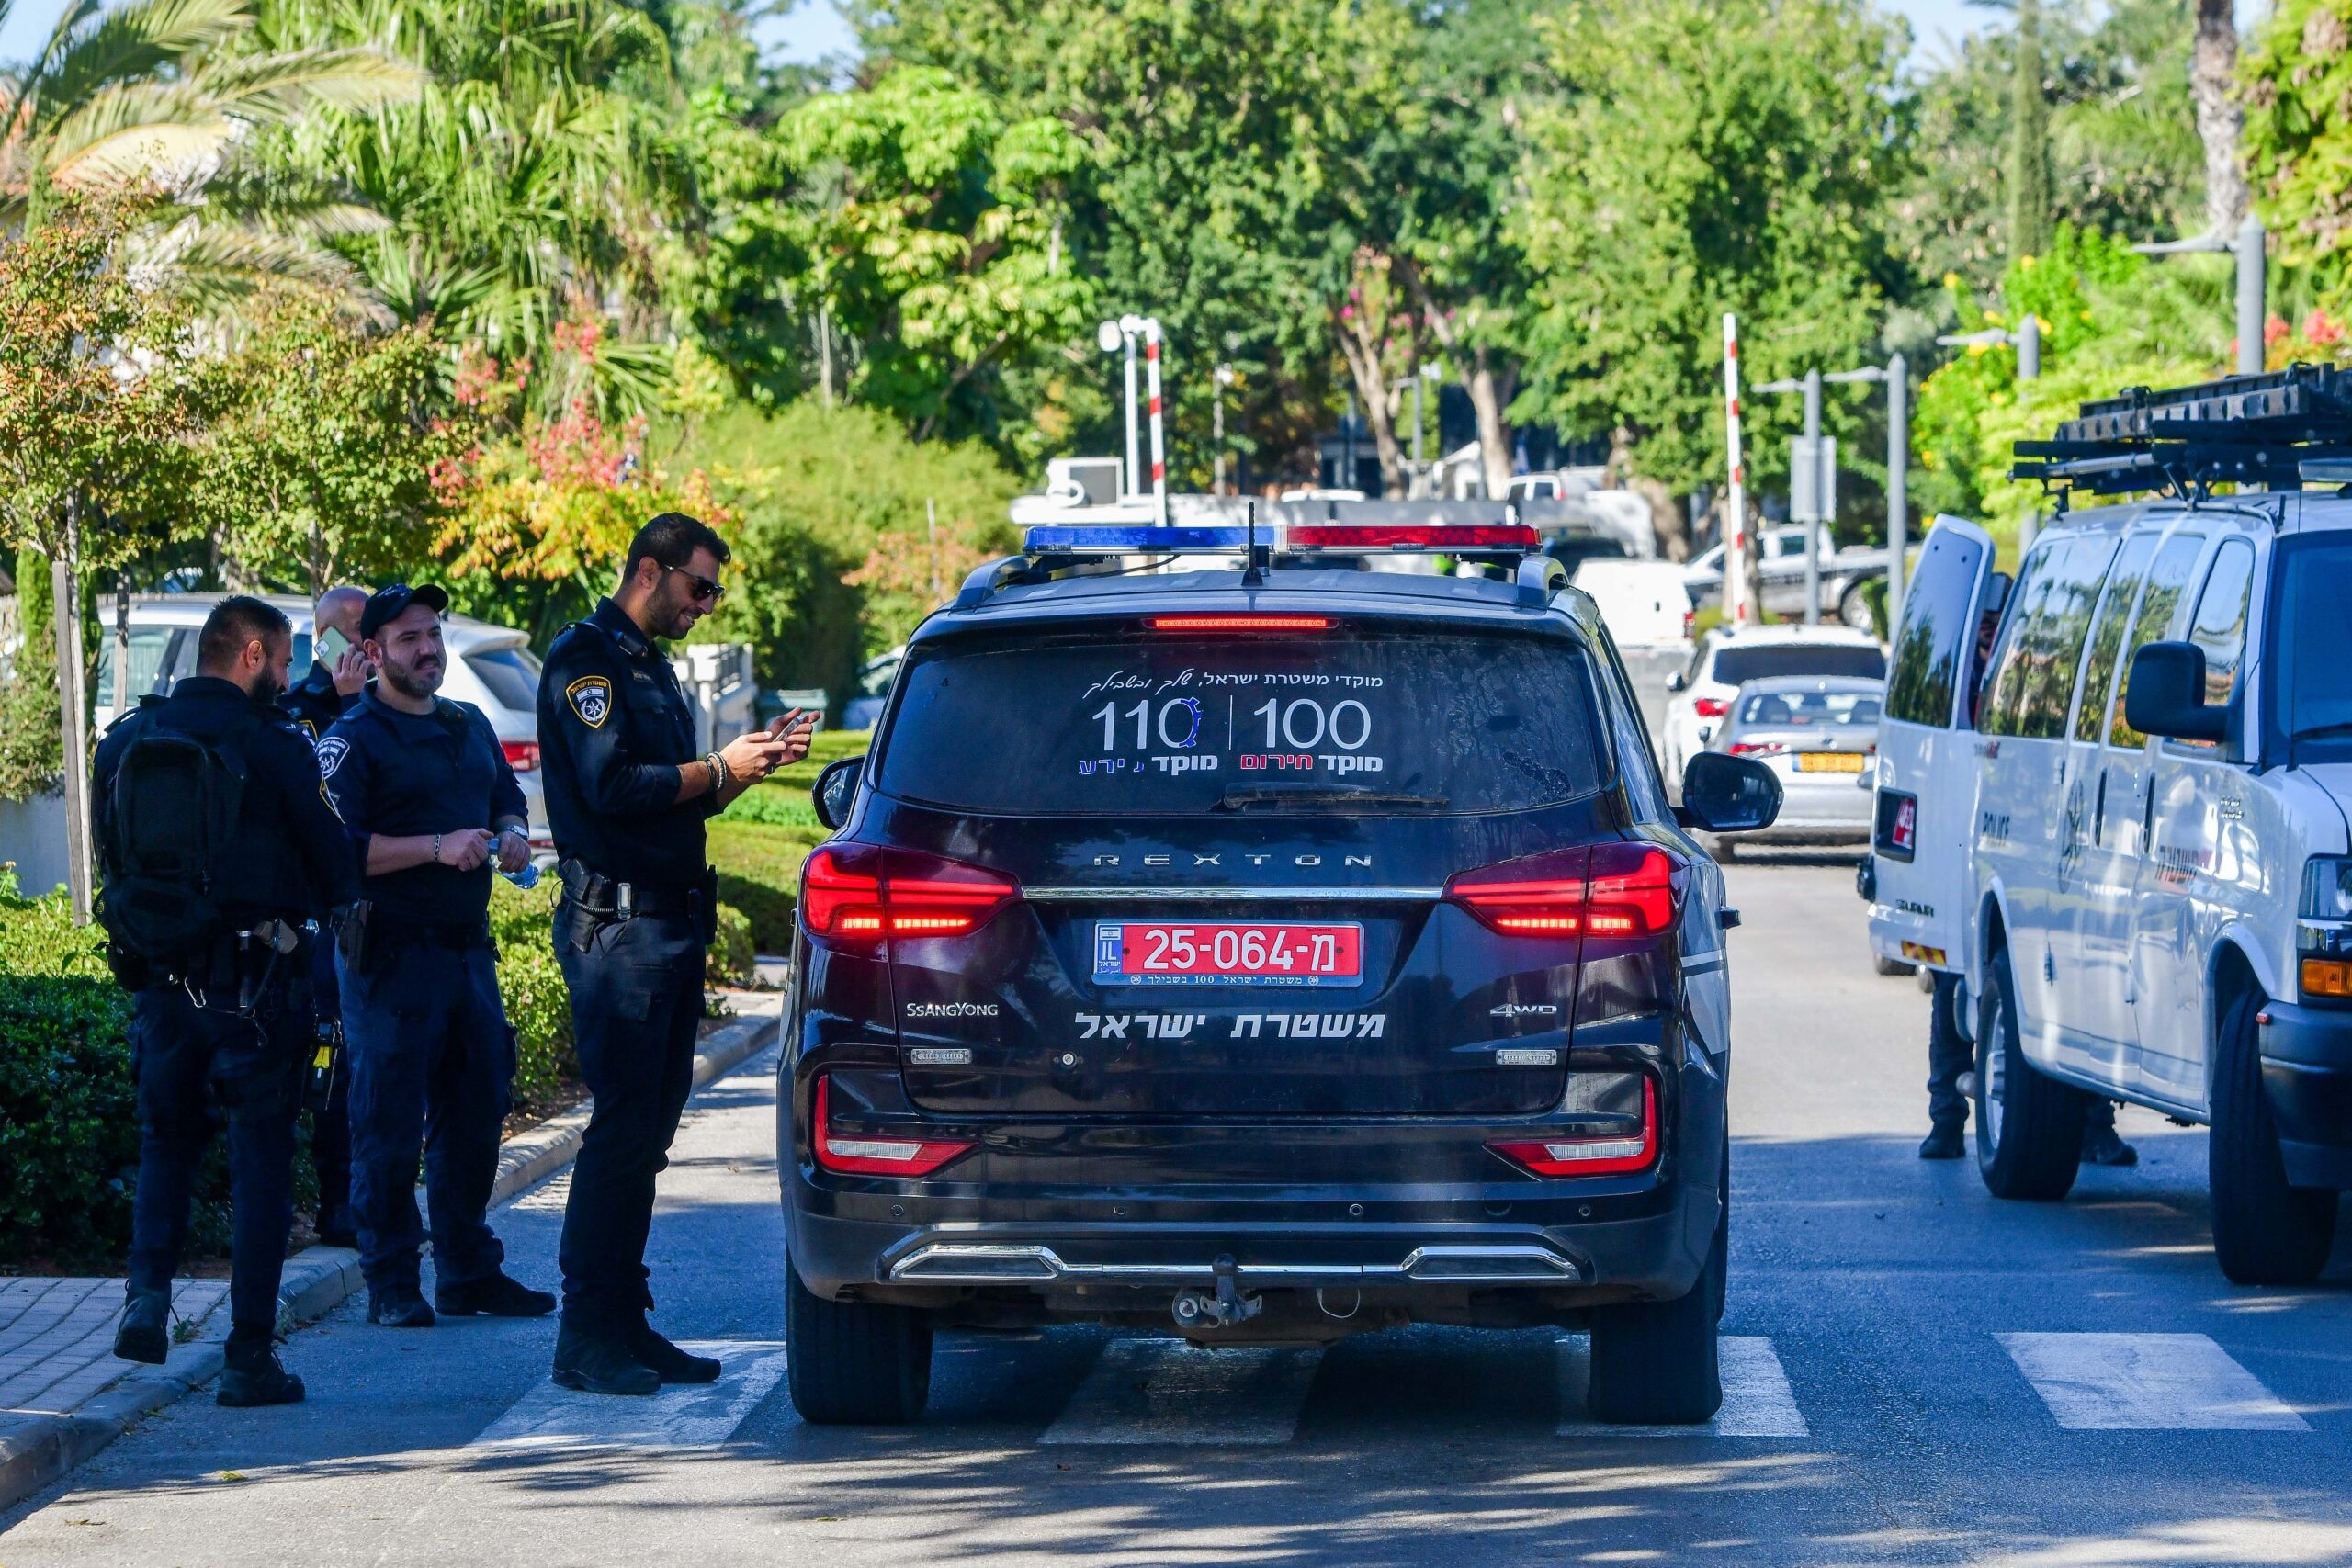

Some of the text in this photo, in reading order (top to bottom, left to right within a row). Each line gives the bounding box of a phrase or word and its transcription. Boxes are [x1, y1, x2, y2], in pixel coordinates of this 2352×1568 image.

[1082, 671, 1152, 699] ובשבילך
[1154, 668, 1194, 696] שלך
[1264, 673, 1329, 685] משטרת
[1335, 675, 1384, 689] מוקדי
[1092, 696, 1203, 751] 110
[1253, 698, 1372, 750] 100
[1151, 755, 1218, 776] מוקד
[1240, 754, 1384, 776] מוקד חירום
[1093, 854, 1372, 866] REXTON
[1102, 941, 1117, 961] IL
[1147, 975, 1302, 985] משטרת ישראל 100 בשבילך
[1489, 1003, 1557, 1017] 4WD
[1074, 1012, 1385, 1039] משטרת ישראל
